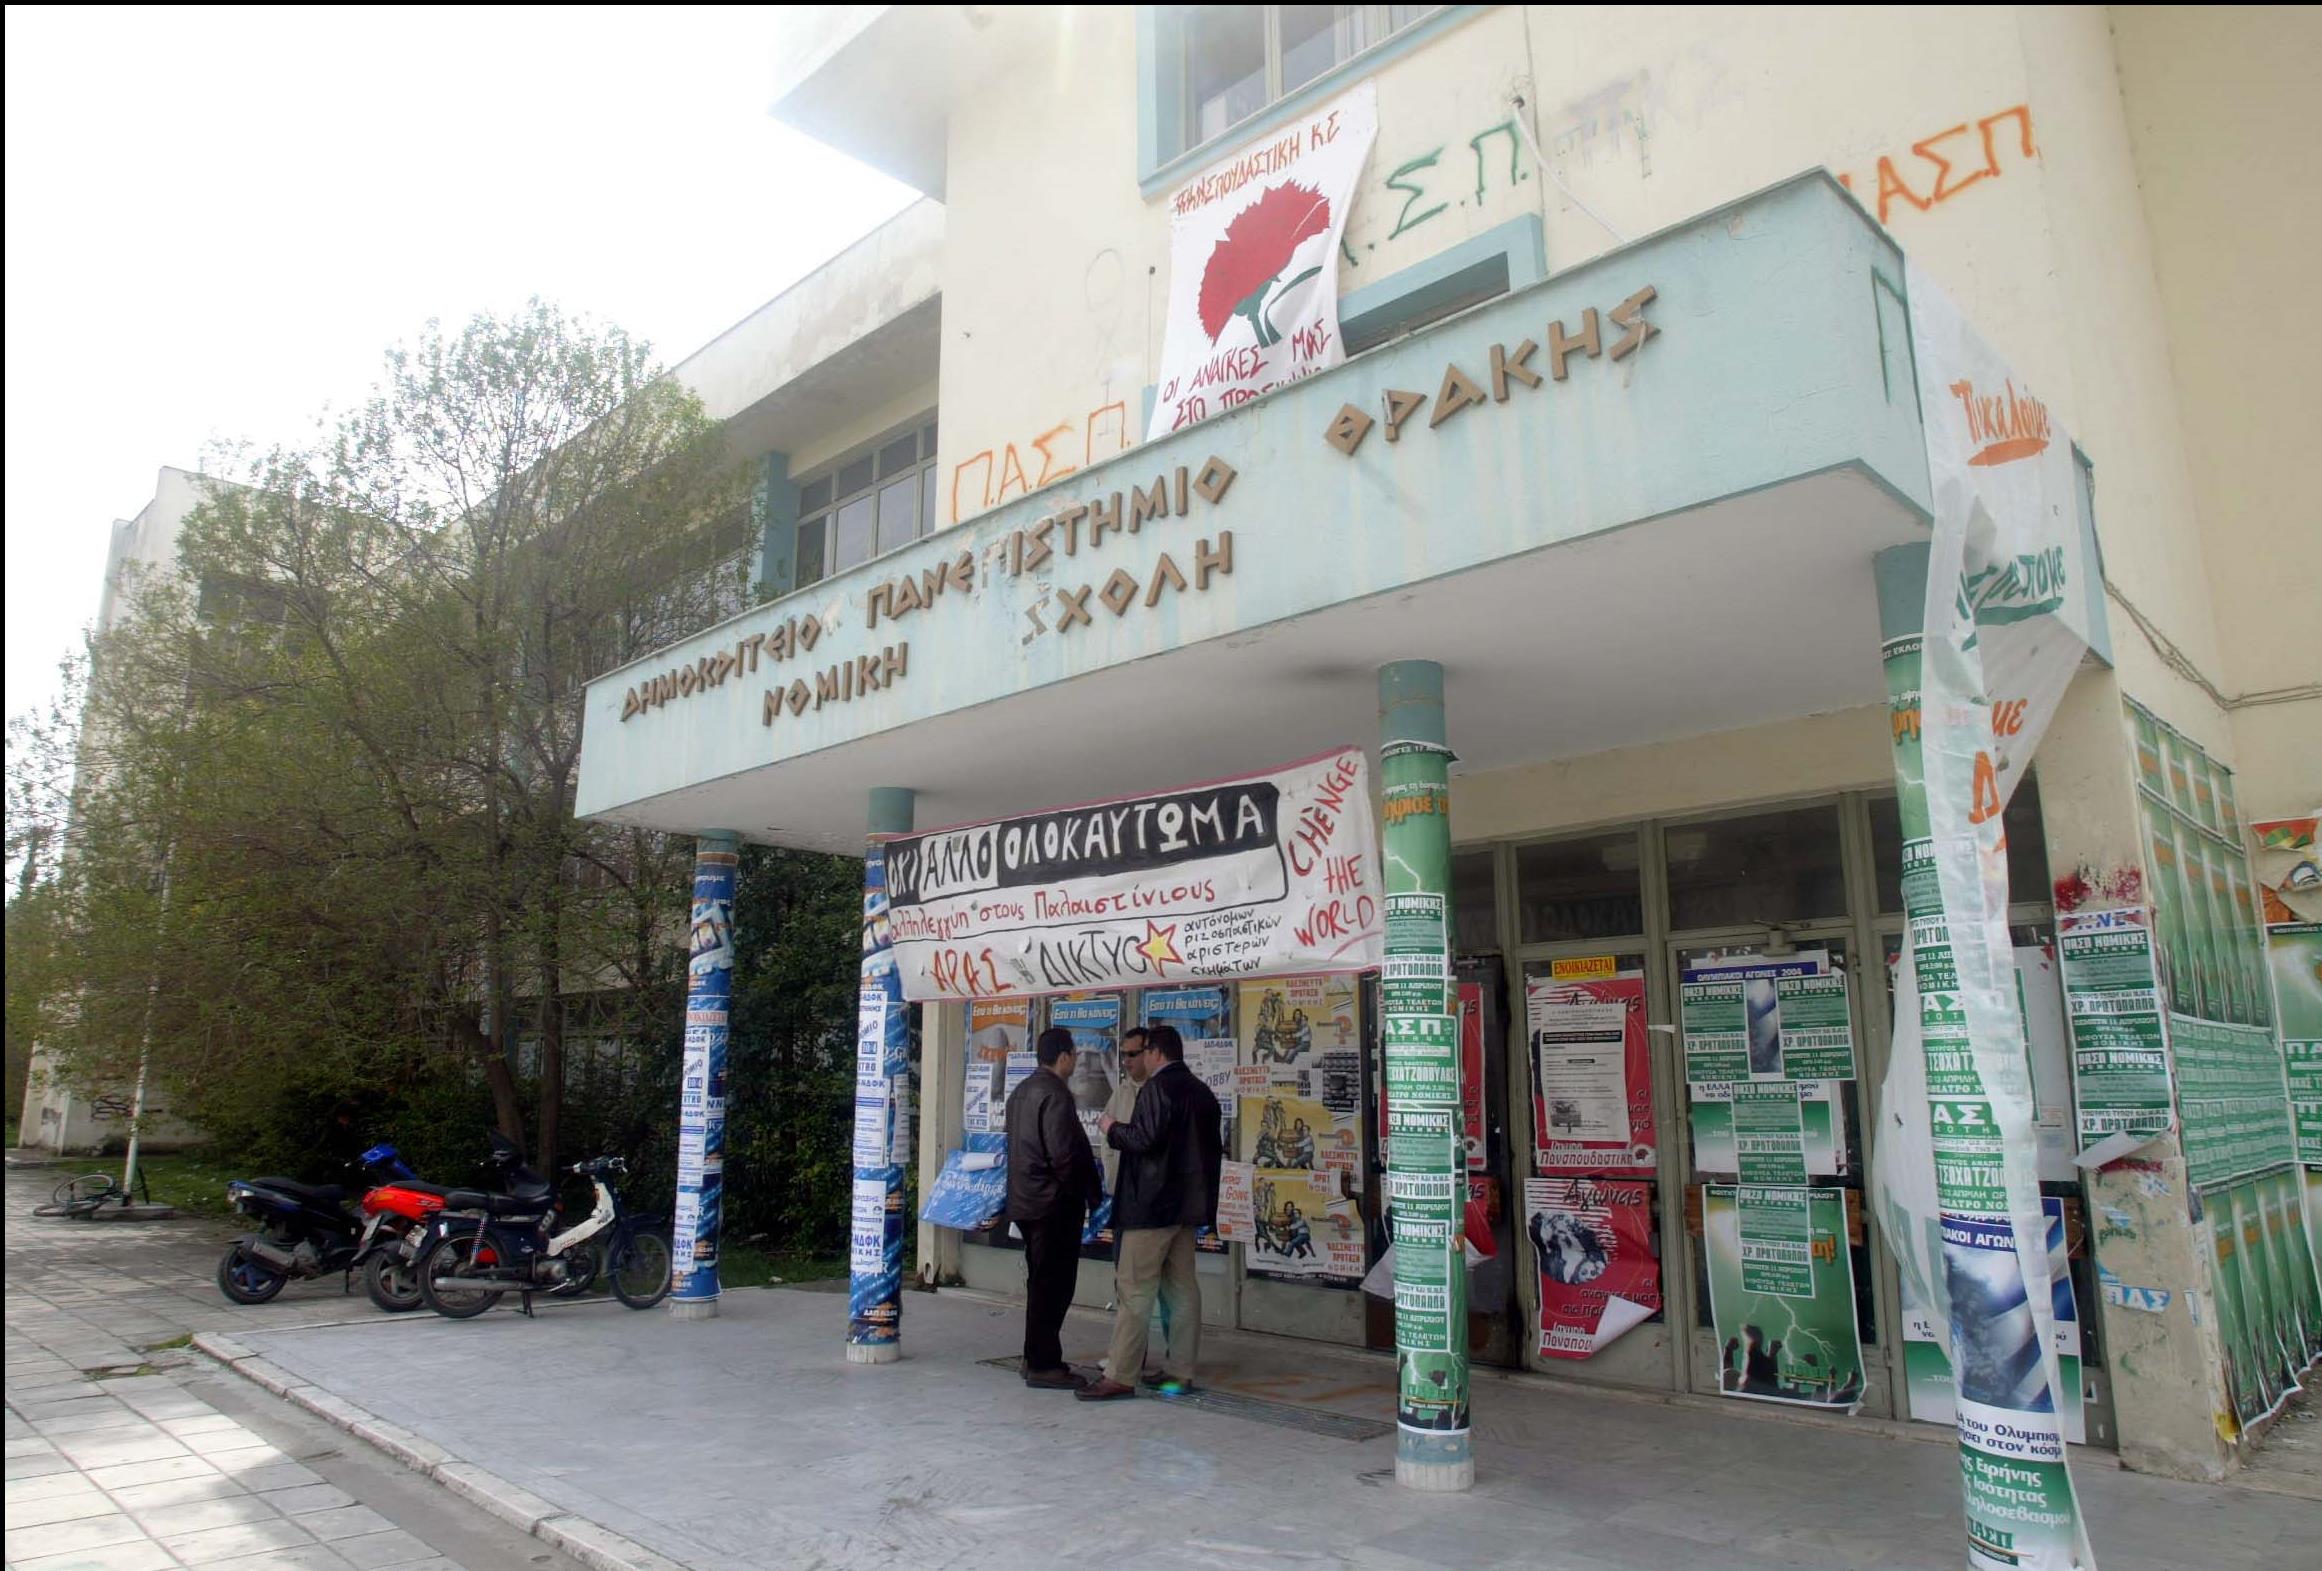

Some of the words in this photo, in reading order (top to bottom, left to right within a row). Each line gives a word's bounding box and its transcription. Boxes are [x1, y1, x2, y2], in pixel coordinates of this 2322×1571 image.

[620, 613, 822, 722] ΔΗΜΟΚΡΙΤΕΙΟ
[1324, 285, 1661, 457] ΘΡΑΚΗΣ
[762, 640, 909, 728] ΝΟΜΙΚΗ
[1021, 530, 1234, 646] ΣΧΟΛΗ
[1004, 793, 1265, 870] ΟΛΟΚΑΥΤΩΜΑ
[979, 903, 1025, 923] στους
[1034, 878, 1216, 920] Παλαιστίνιους
[1294, 895, 1375, 948] WORLD
[1554, 958, 1614, 976] ΕΝΟΙΚΙΑΖΕΤΑΙ
